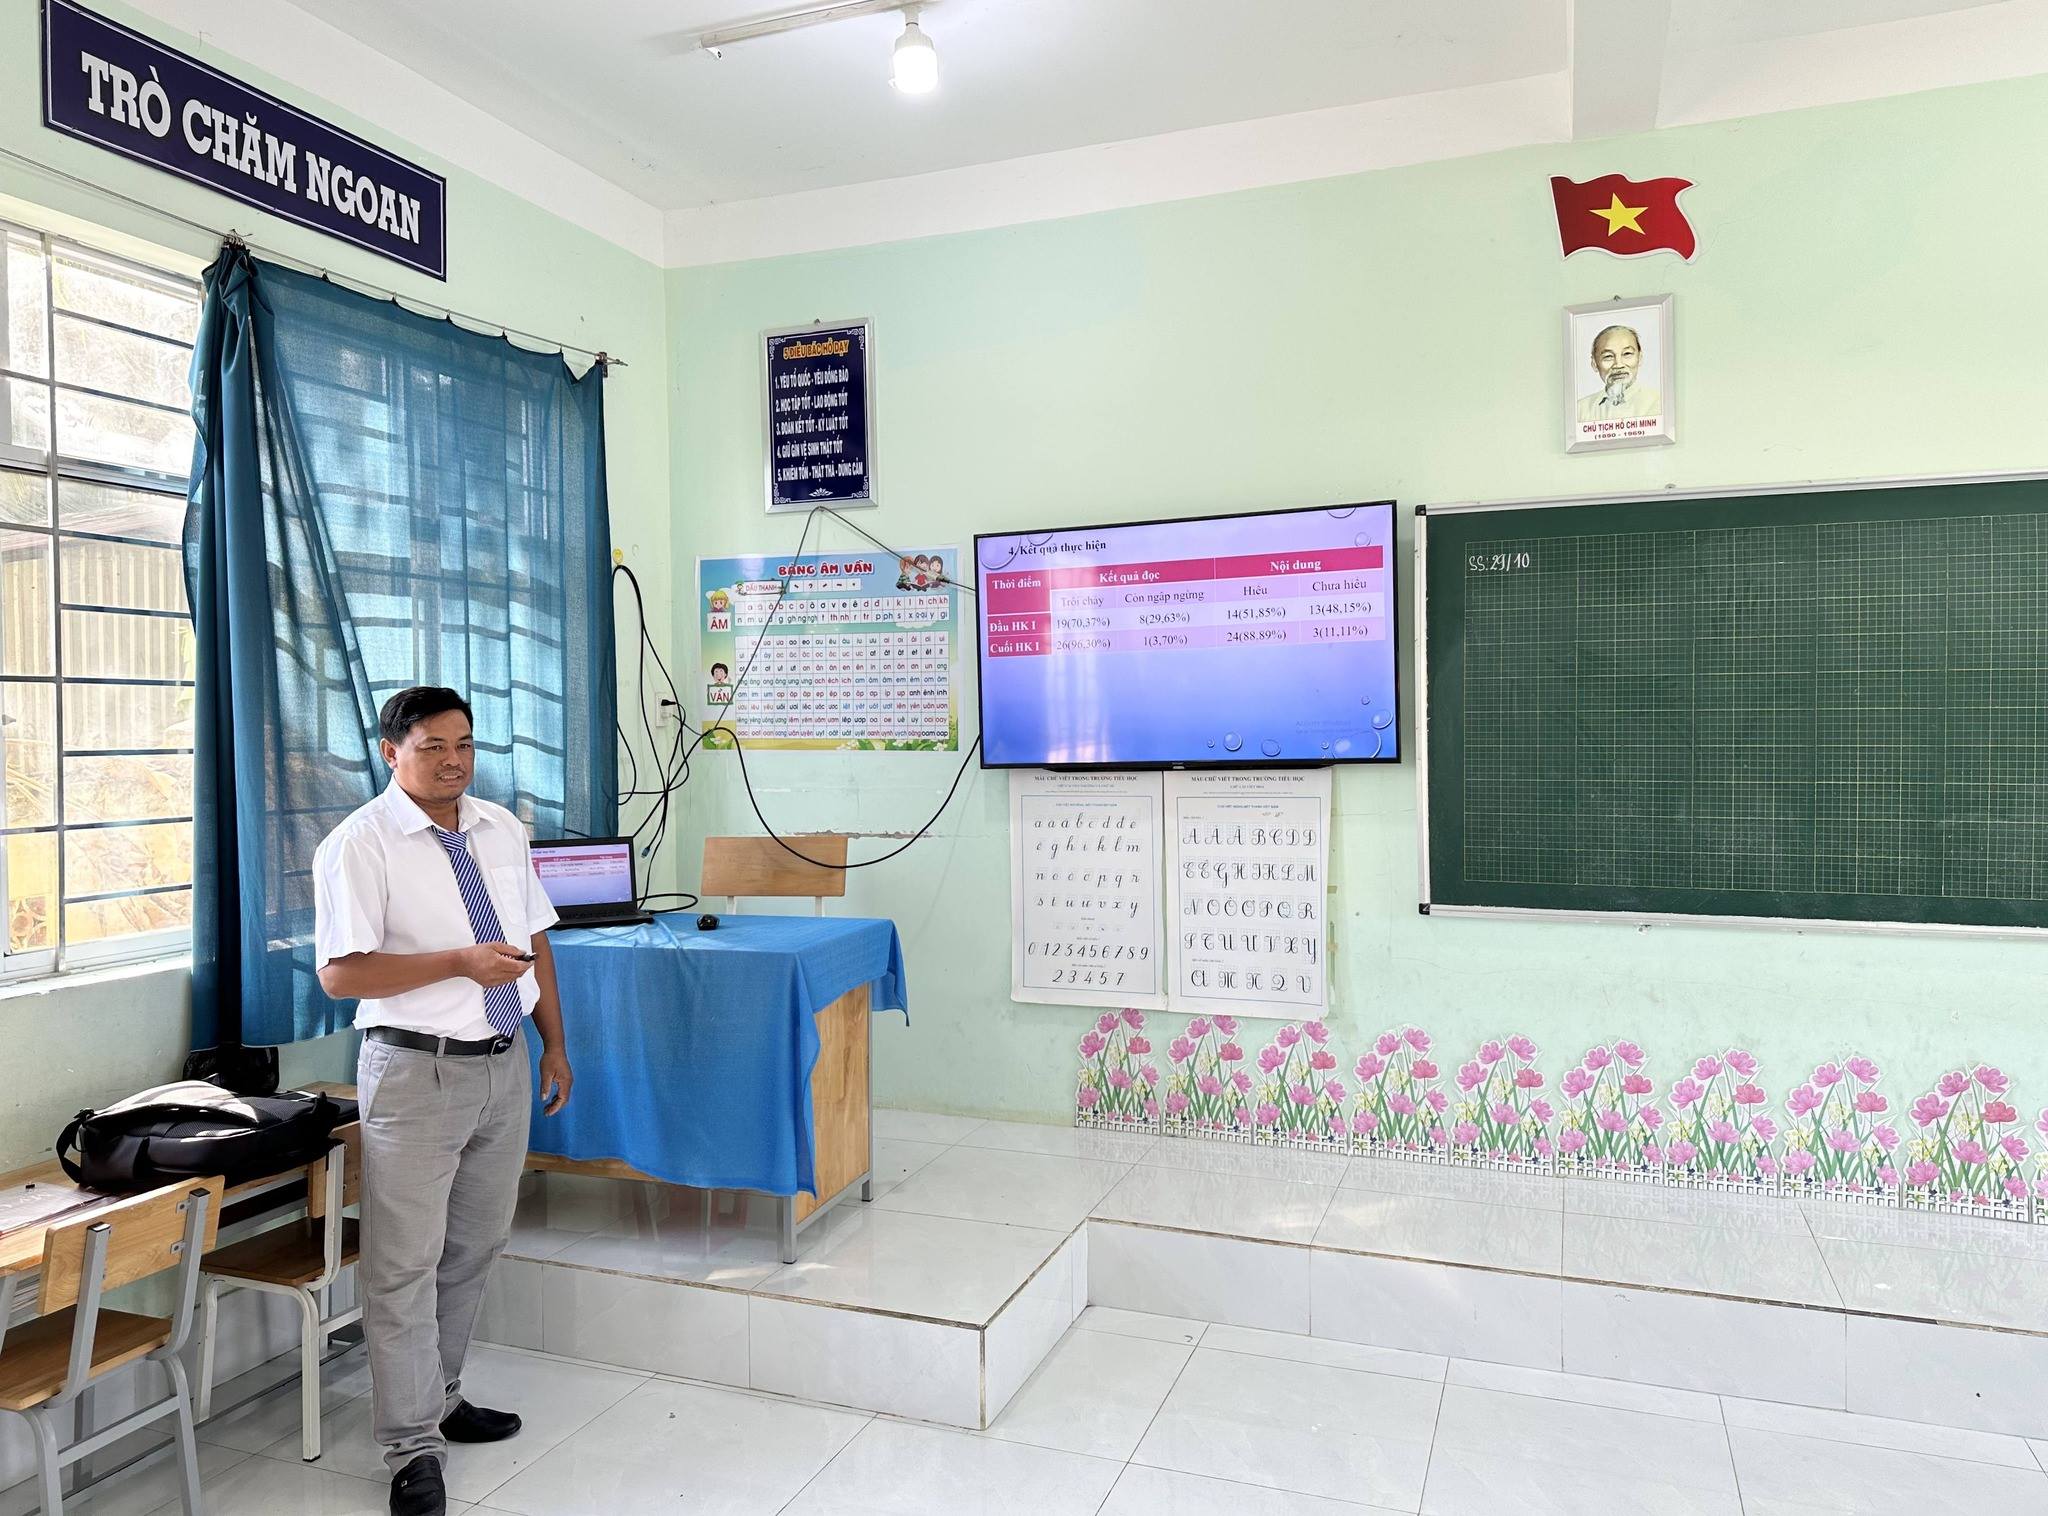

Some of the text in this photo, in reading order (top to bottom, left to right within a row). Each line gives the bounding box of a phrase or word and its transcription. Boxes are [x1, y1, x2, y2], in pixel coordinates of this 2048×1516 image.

[82, 51, 420, 243] TRÒ CHĂM NGOAN
[834, 340, 849, 356] DẠY
[814, 395, 823, 408] LAO
[1583, 422, 1596, 432] CHỦ
[1599, 423, 1613, 433] TỊCH
[1640, 419, 1656, 427] MINH
[1020, 544, 1037, 555] Kết
[1060, 543, 1081, 553] thực
[1085, 540, 1106, 552] hiện
[779, 563, 815, 576] BẢNG
[821, 563, 838, 573] ÂM
[1270, 560, 1321, 573] Nội dung
[1100, 570, 1160, 583] Kết quả đọc
[992, 580, 1015, 589] Thời
[1312, 581, 1340, 591] Chưa
[1227, 607, 1286, 620] 14(51,85%)
[1310, 602, 1372, 616] 13(48,15%)
[711, 617, 728, 629] ÂM
[1057, 618, 1110, 630] 19(70,37%)
[1139, 612, 1190, 625] 8(29,63%)
[990, 620, 1009, 632] Đầu
[1012, 622, 1029, 631] HK
[1313, 625, 1368, 639] 3(11,11%)
[990, 640, 1013, 653] Cuối
[1016, 643, 1032, 652] HK
[1144, 635, 1188, 646] 1(3,70%)
[1183, 828, 1200, 844] A
[1251, 829, 1266, 845] B
[1269, 829, 1283, 845] C
[1207, 899, 1220, 916] O
[1224, 897, 1237, 917] Ô
[1298, 902, 1316, 919] R
[1028, 942, 1148, 960] 0 1 2 3 4 5 6 7 8 9
[1052, 970, 1125, 985] 2 3 4 5 7
